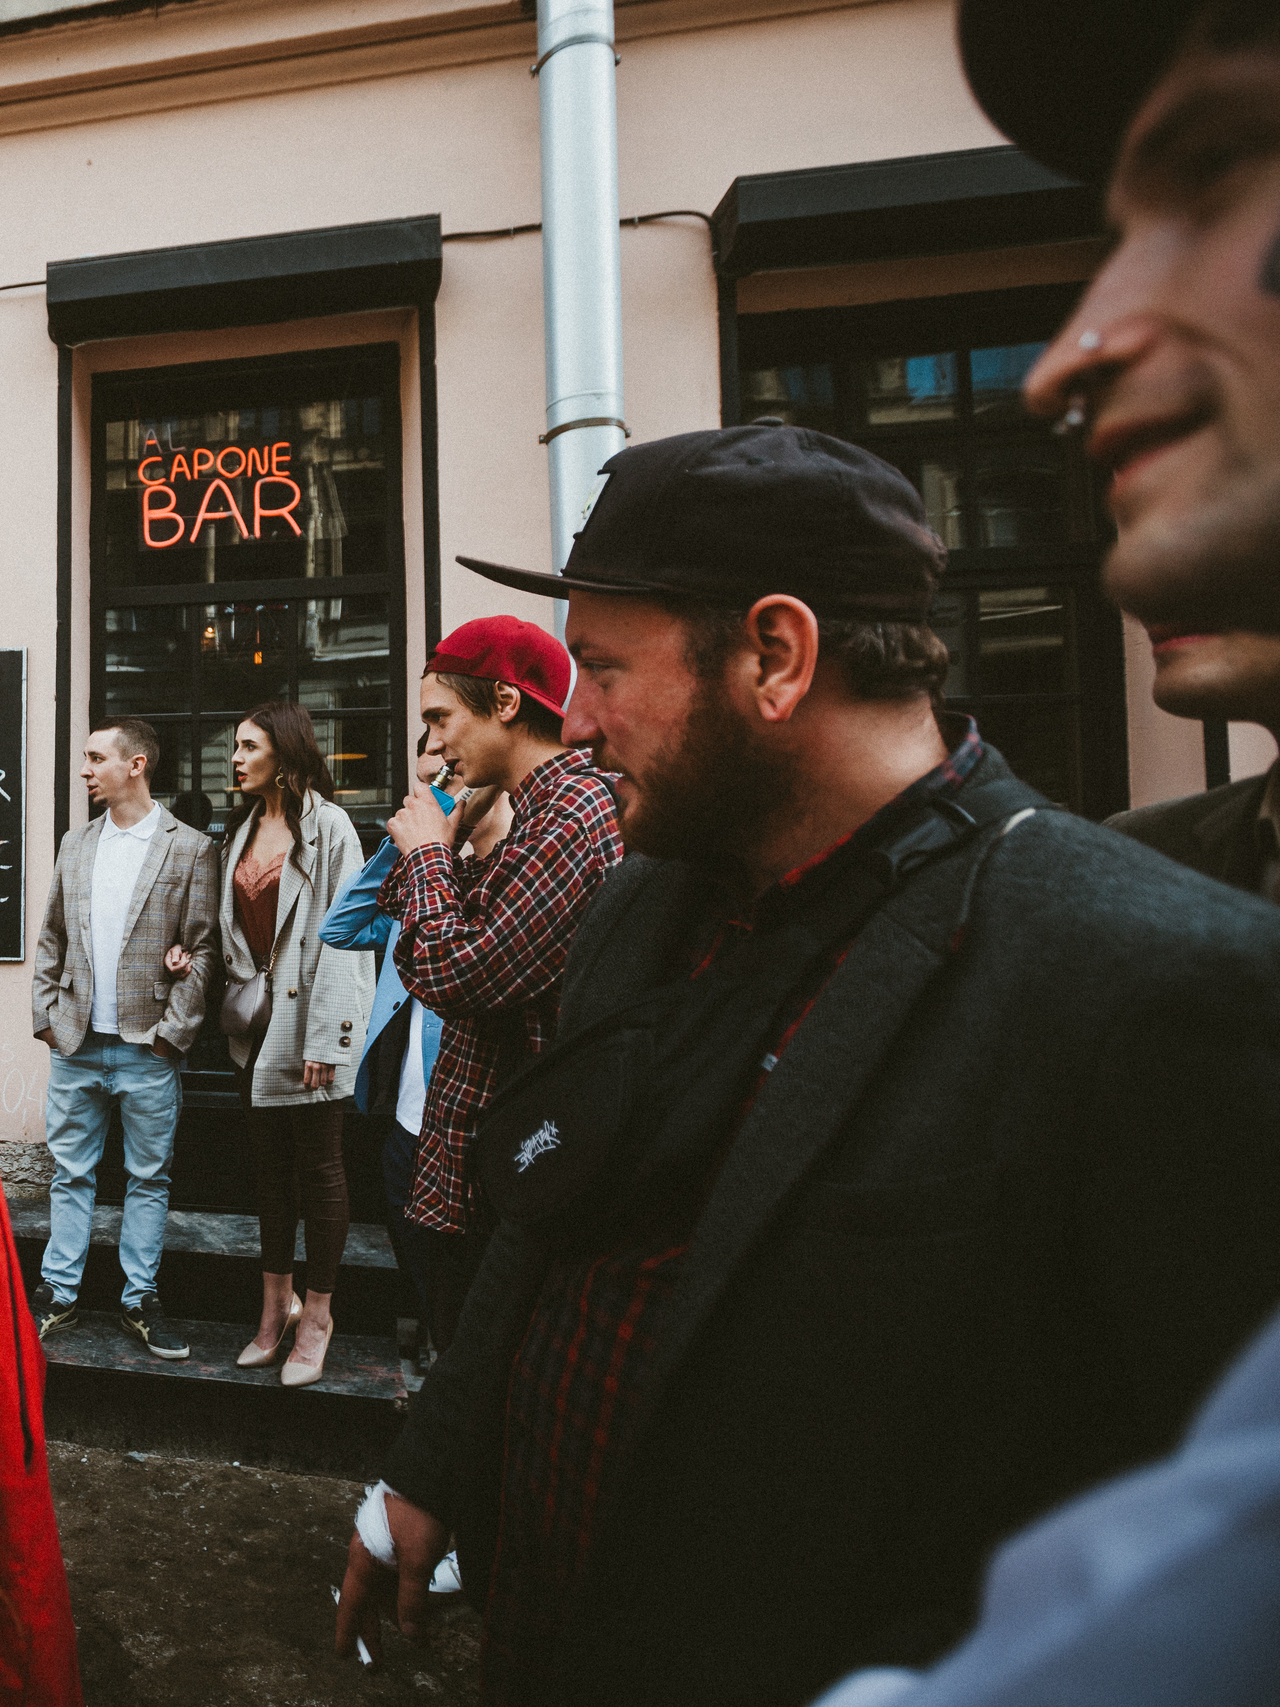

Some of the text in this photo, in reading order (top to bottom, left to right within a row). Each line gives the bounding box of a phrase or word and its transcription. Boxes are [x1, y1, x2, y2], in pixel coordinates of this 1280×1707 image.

[143, 424, 187, 454] AL
[138, 442, 292, 486] CAPONE
[142, 476, 303, 548] BAR
